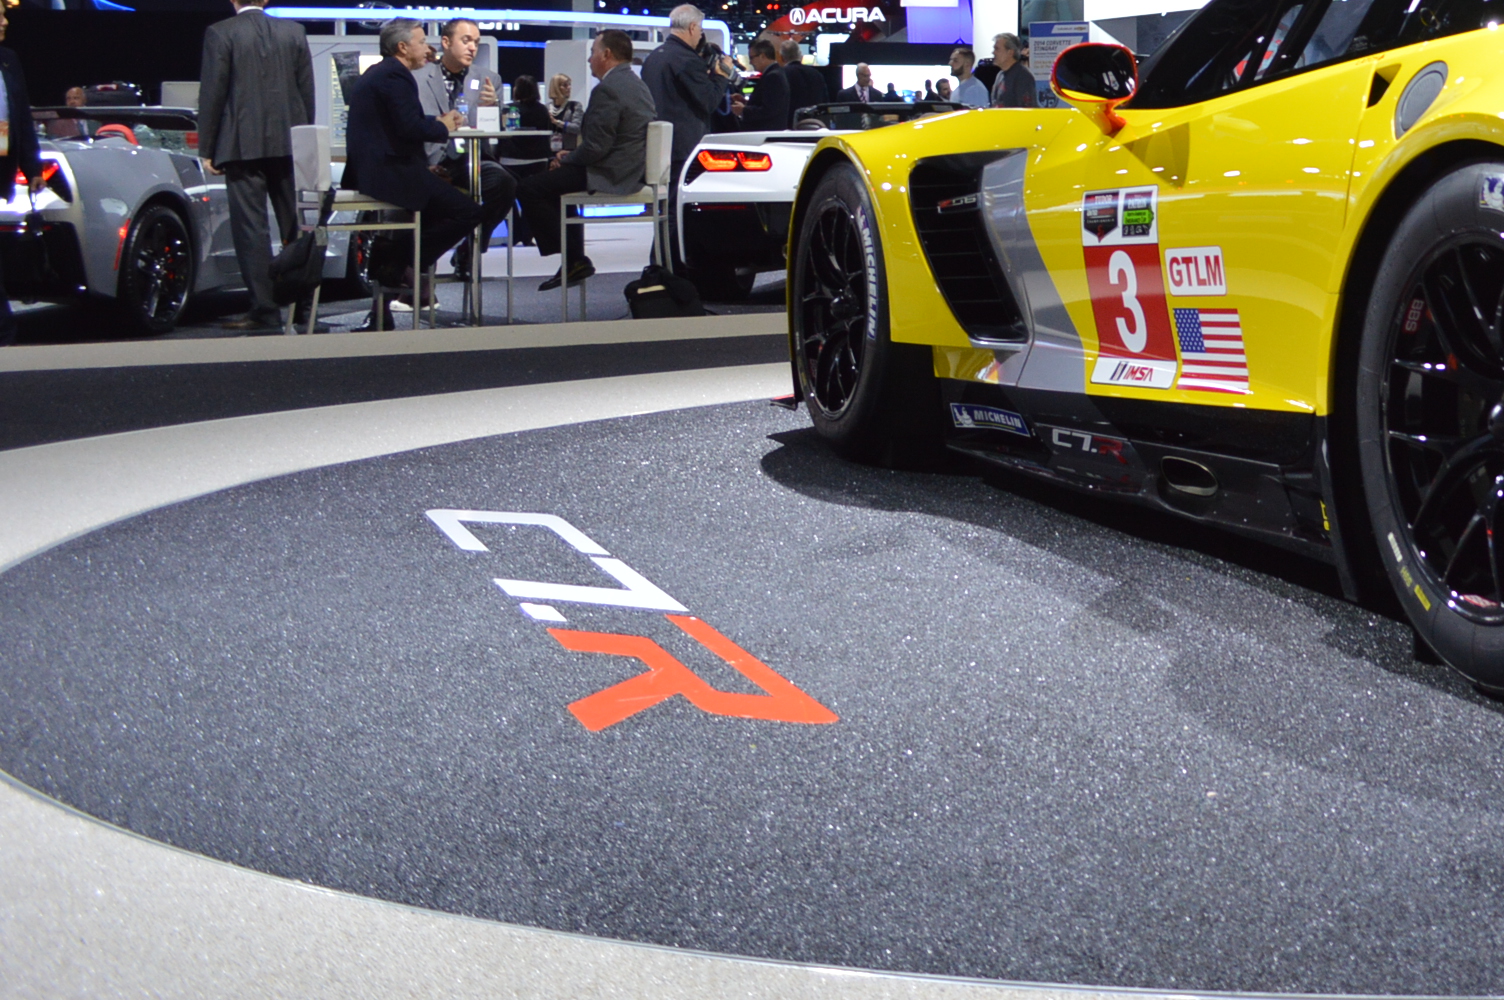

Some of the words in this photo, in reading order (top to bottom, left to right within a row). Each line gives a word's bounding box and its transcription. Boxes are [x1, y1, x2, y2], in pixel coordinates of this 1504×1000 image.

[805, 6, 886, 24] ACURA
[862, 228, 878, 340] MICHELIN
[1169, 254, 1223, 288] GTLM
[1108, 249, 1148, 354] 3
[1405, 299, 1425, 332] BBS
[973, 409, 1023, 430] MICHELIN
[1052, 428, 1129, 465] C7.R
[425, 508, 840, 732] C7.R
